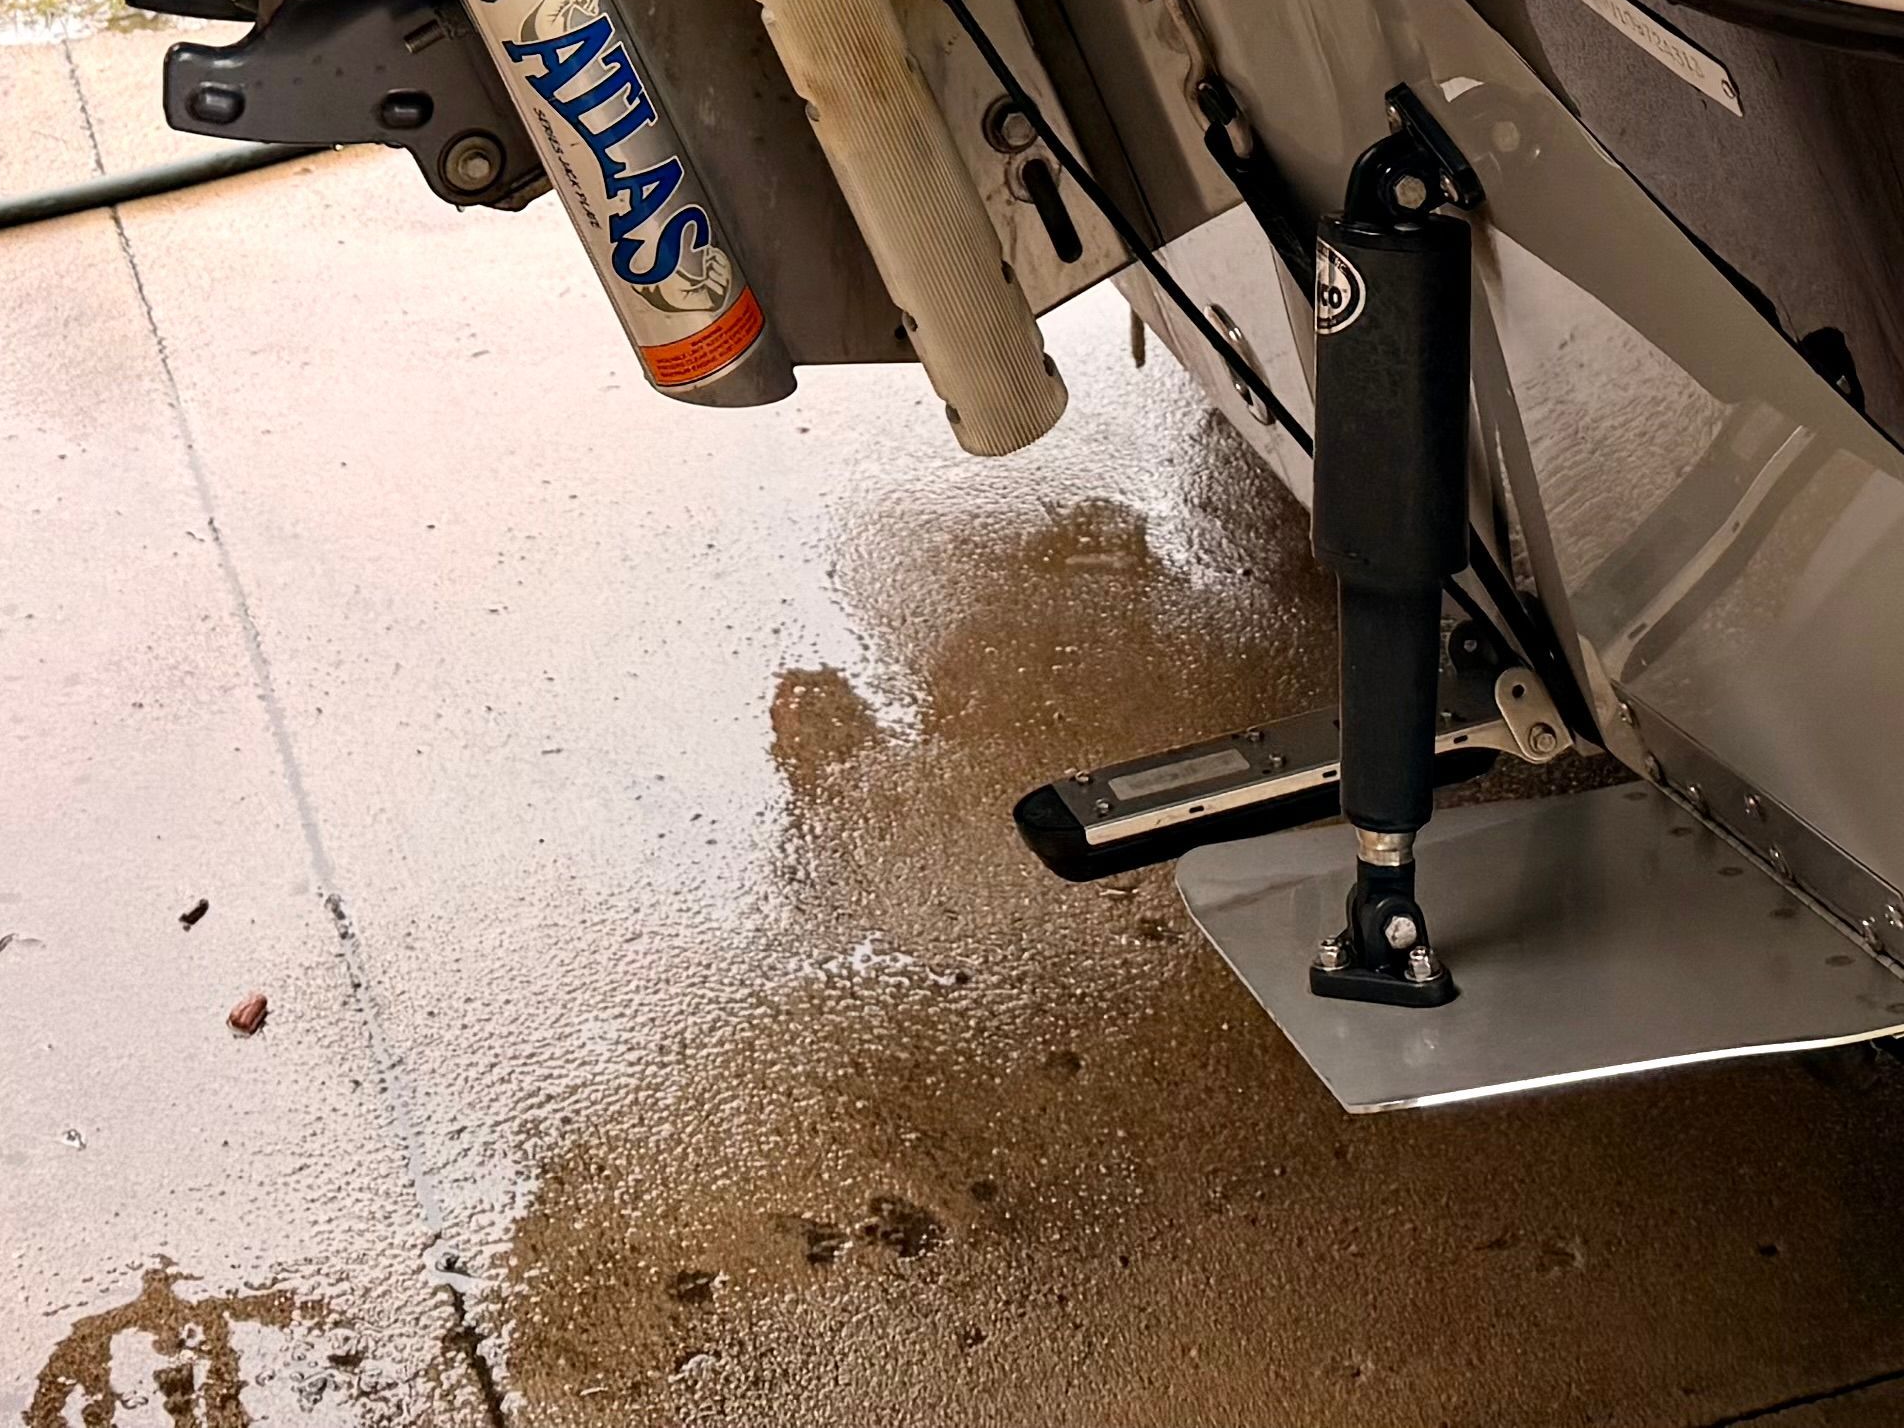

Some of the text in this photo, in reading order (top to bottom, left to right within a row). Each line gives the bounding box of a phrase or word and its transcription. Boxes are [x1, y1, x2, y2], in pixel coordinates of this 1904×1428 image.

[501, 13, 713, 286] ATLAS
[533, 107, 602, 230] SERIES JACK PLATE
